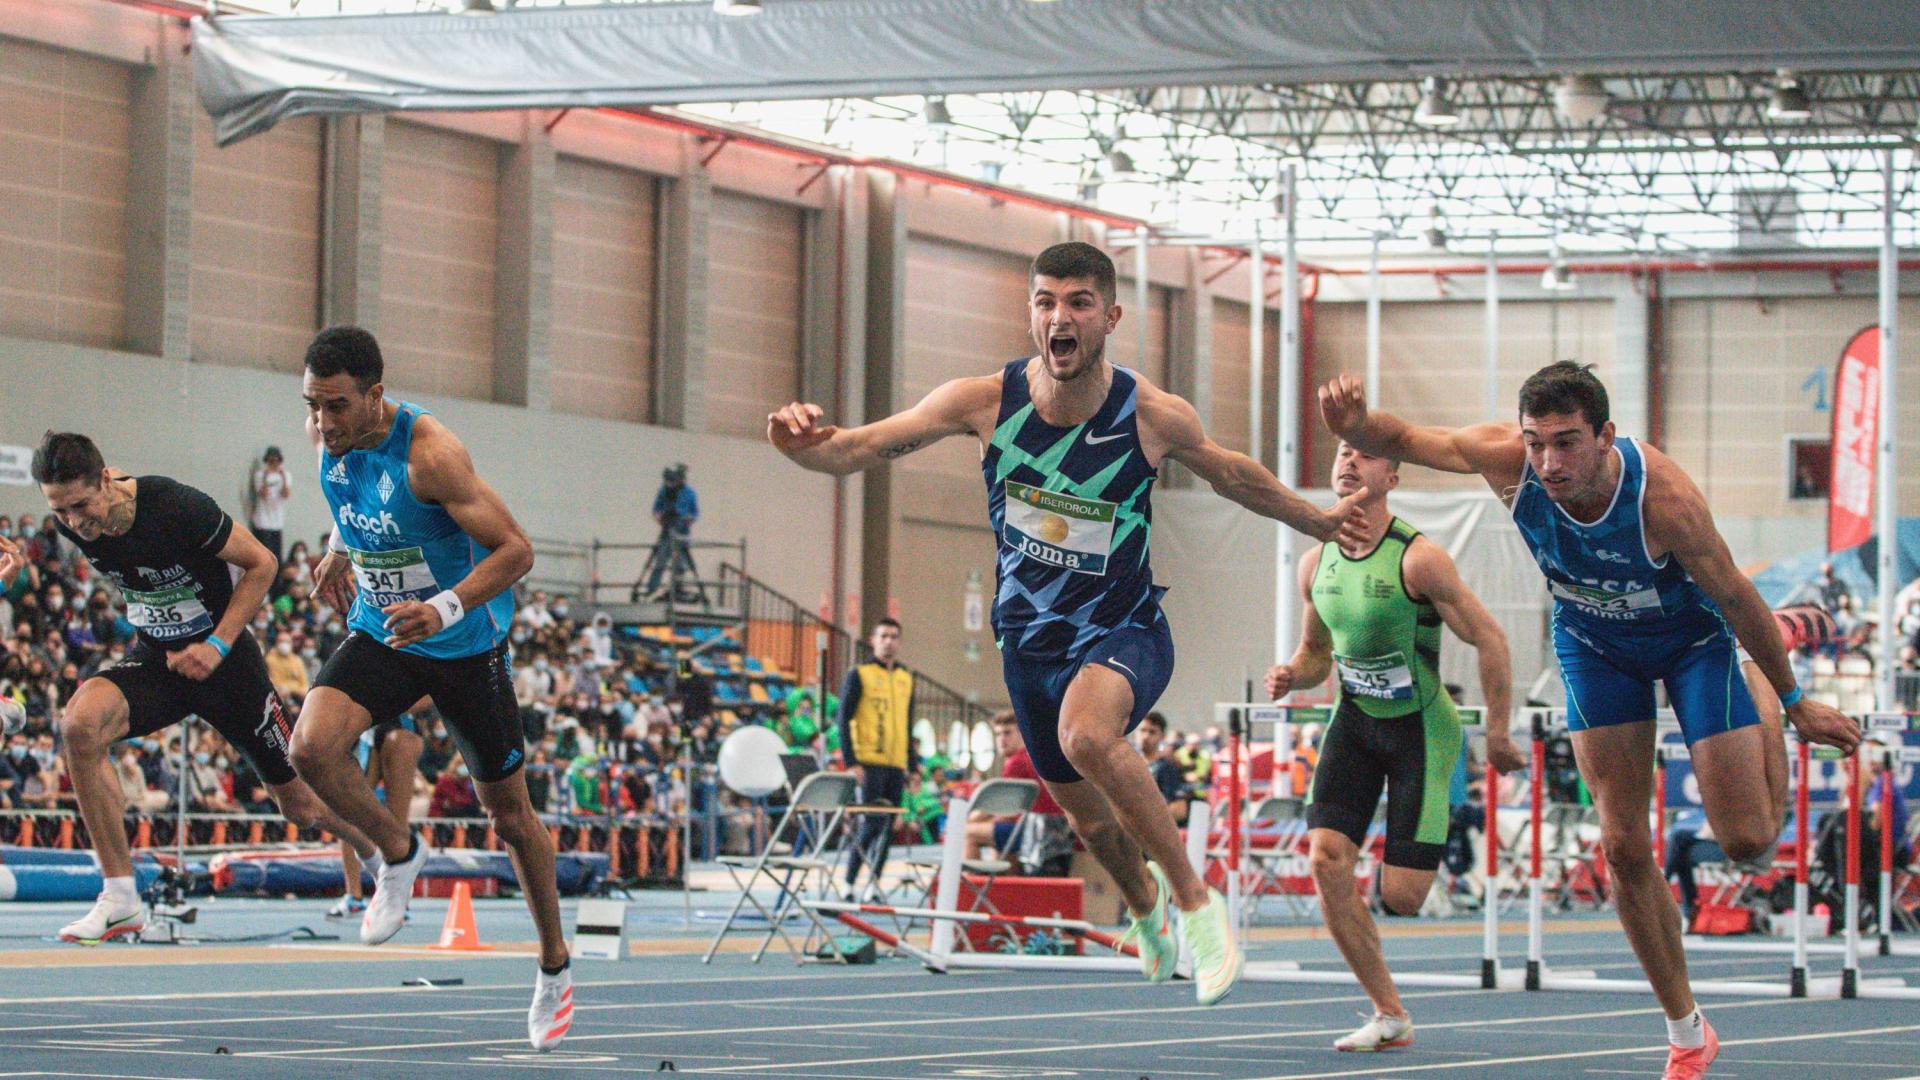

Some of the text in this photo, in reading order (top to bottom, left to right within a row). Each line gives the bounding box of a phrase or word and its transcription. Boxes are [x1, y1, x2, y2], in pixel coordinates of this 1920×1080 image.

[326, 474, 349, 485] adidas
[1040, 496, 1100, 516] IBERDROLA
[364, 571, 404, 591] 347
[145, 606, 183, 623] 336
